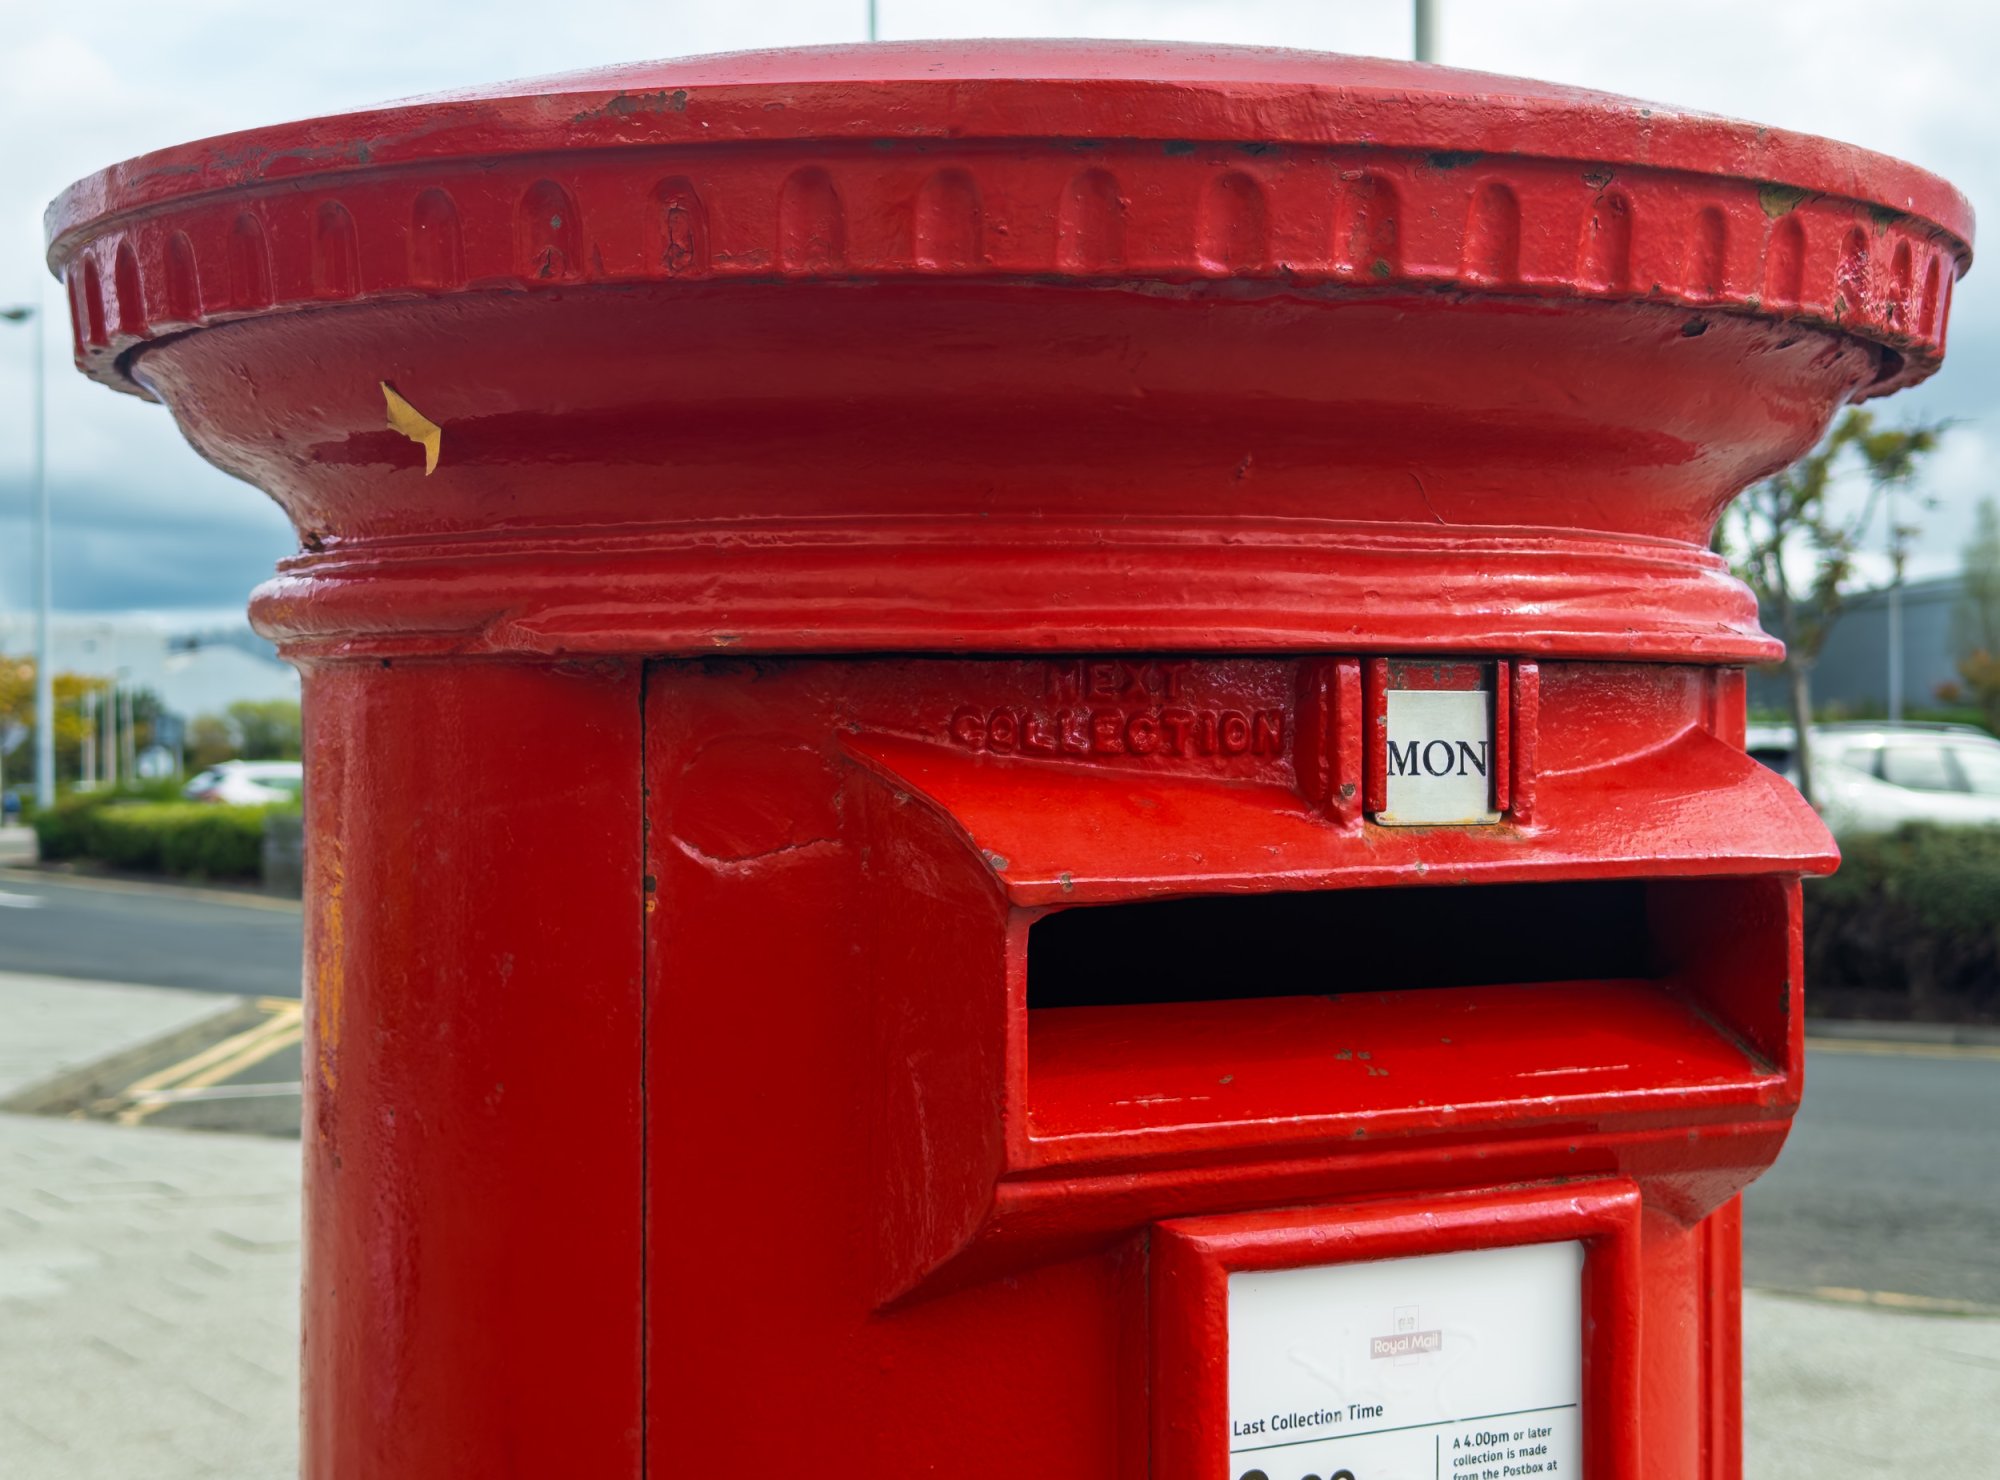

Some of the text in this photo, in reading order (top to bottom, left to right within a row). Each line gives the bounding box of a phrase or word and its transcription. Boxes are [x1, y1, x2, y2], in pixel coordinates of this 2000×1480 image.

[1052, 660, 1190, 698] NEXT
[952, 705, 1286, 755] COLLECTION
[1387, 740, 1488, 776] MON
[1375, 1332, 1438, 1354] Royal Mail
[1234, 1404, 1383, 1436] Last Collection Time
[1453, 1427, 1552, 1449] A 4.00pm or later
[1453, 1444, 1547, 1467] collection is made
[1483, 1469, 1499, 1480] the
[1503, 1463, 1543, 1477] Postbox
[1547, 1460, 1557, 1471] at
